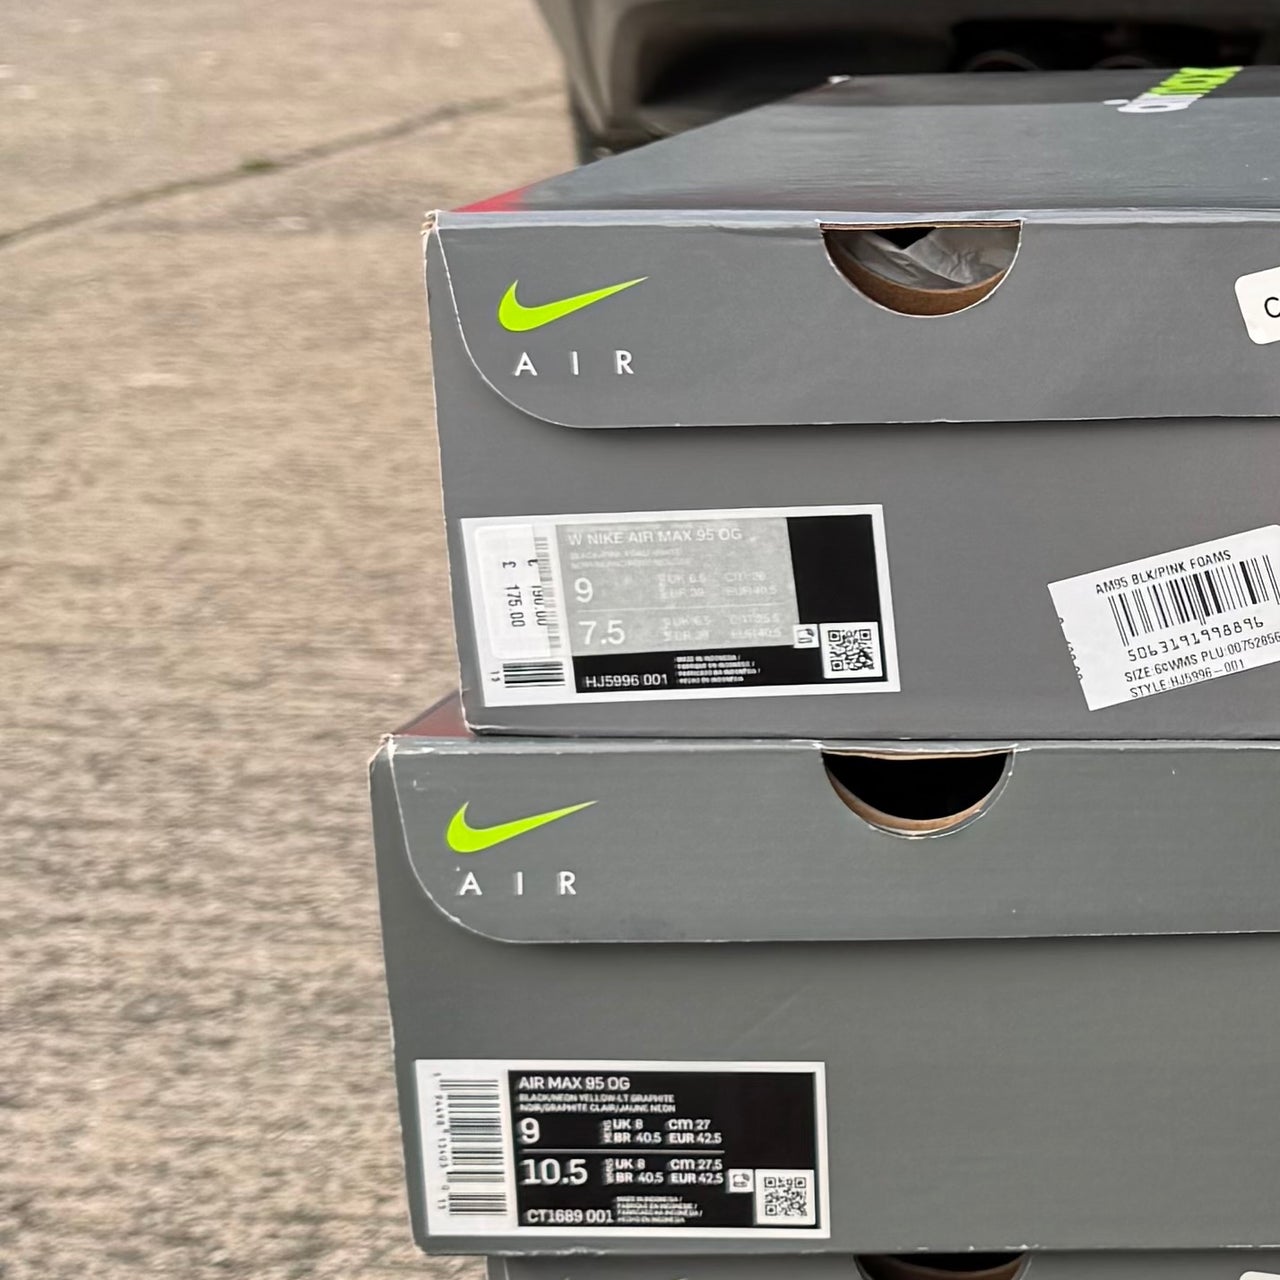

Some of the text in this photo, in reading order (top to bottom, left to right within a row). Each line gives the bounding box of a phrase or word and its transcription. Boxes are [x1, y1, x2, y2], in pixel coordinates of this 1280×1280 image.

[513, 349, 635, 377] AIR
[568, 528, 742, 546] W NIKE AIR MAX 95 OG
[1096, 550, 1231, 594] AM95 BLK/PINK FOAMS
[574, 577, 593, 603] 9
[578, 620, 625, 645] 7.5
[1128, 616, 1264, 662] 5063191998896
[585, 673, 668, 687] HJ5996 001
[458, 870, 577, 896] AIR
[519, 1077, 631, 1090] AIR MAX 95 OG
[520, 1117, 540, 1144] 9
[613, 1119, 711, 1130] UK 8 cm 27
[613, 1133, 722, 1144] BR 40.5 EUR 42.5
[520, 1158, 588, 1185] 10.5
[527, 1209, 583, 1223] CT1689
[586, 1210, 614, 1223] 001
